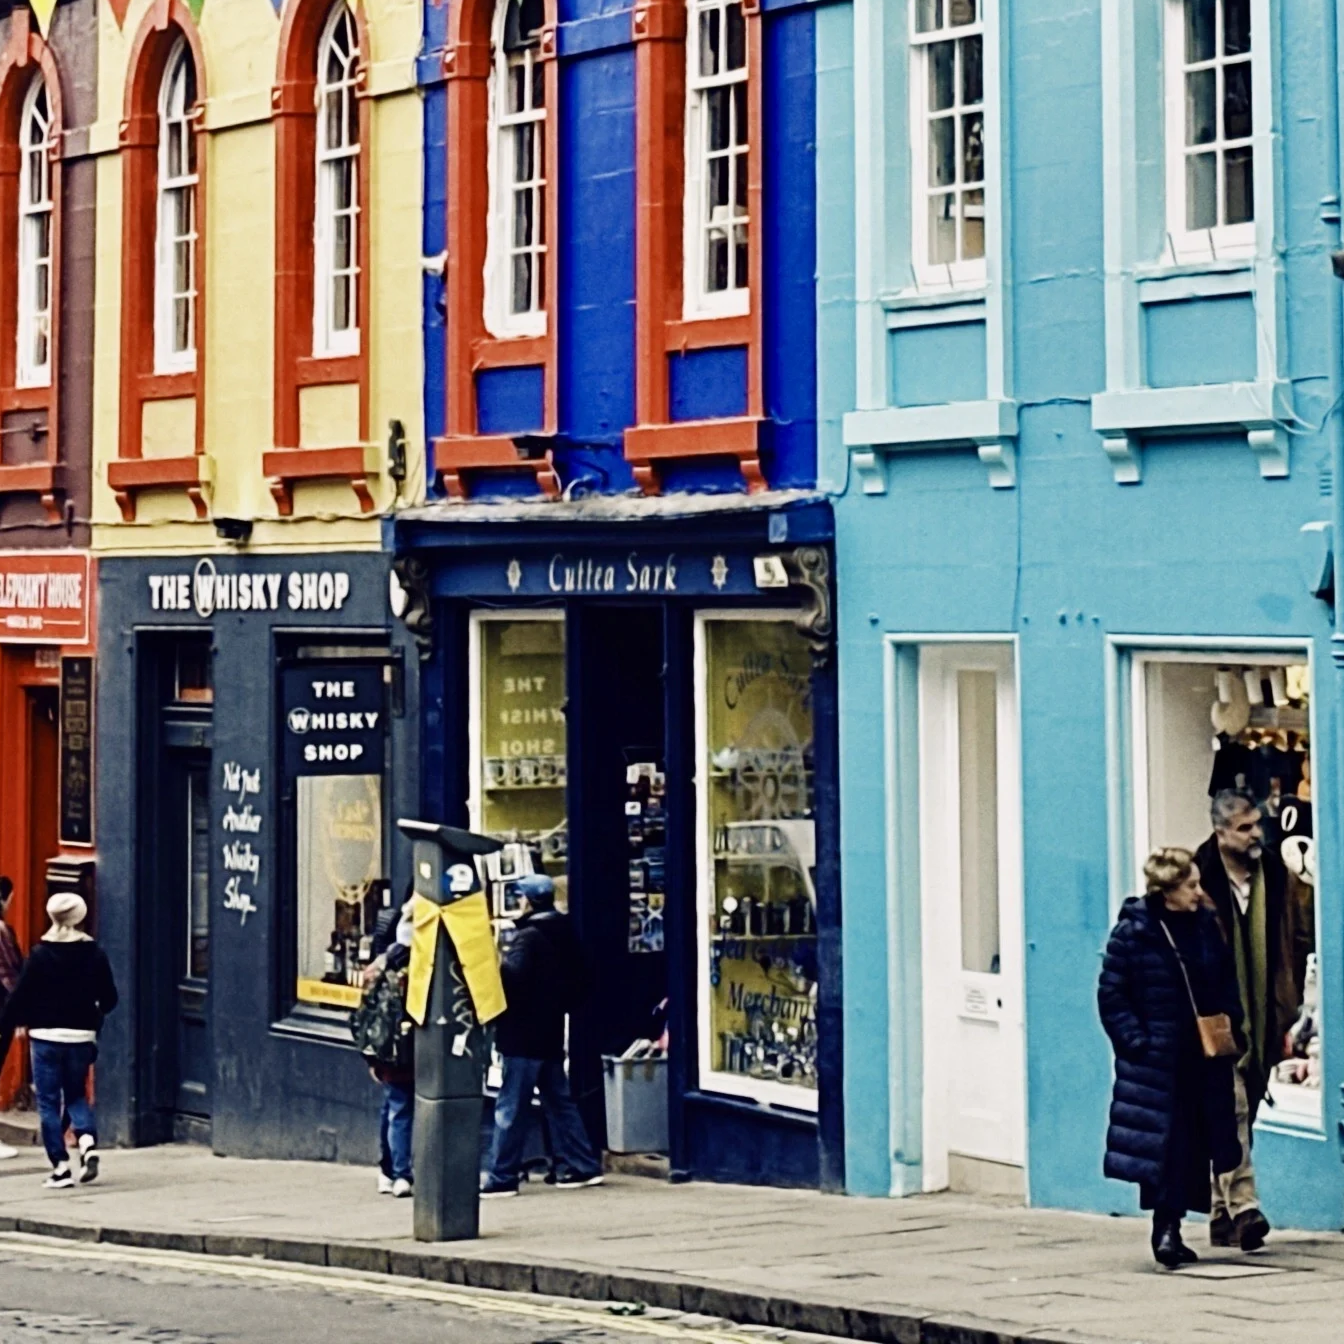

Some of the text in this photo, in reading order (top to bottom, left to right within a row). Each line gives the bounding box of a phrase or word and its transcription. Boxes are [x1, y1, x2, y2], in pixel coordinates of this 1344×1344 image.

[548, 551, 677, 593] Cuttea Sark
[47, 572, 82, 609] HOUSE
[148, 570, 350, 612] THE WHISKY SHOP
[311, 681, 356, 698] THE
[288, 711, 379, 731] WHISKY
[303, 743, 364, 762] SHOP
